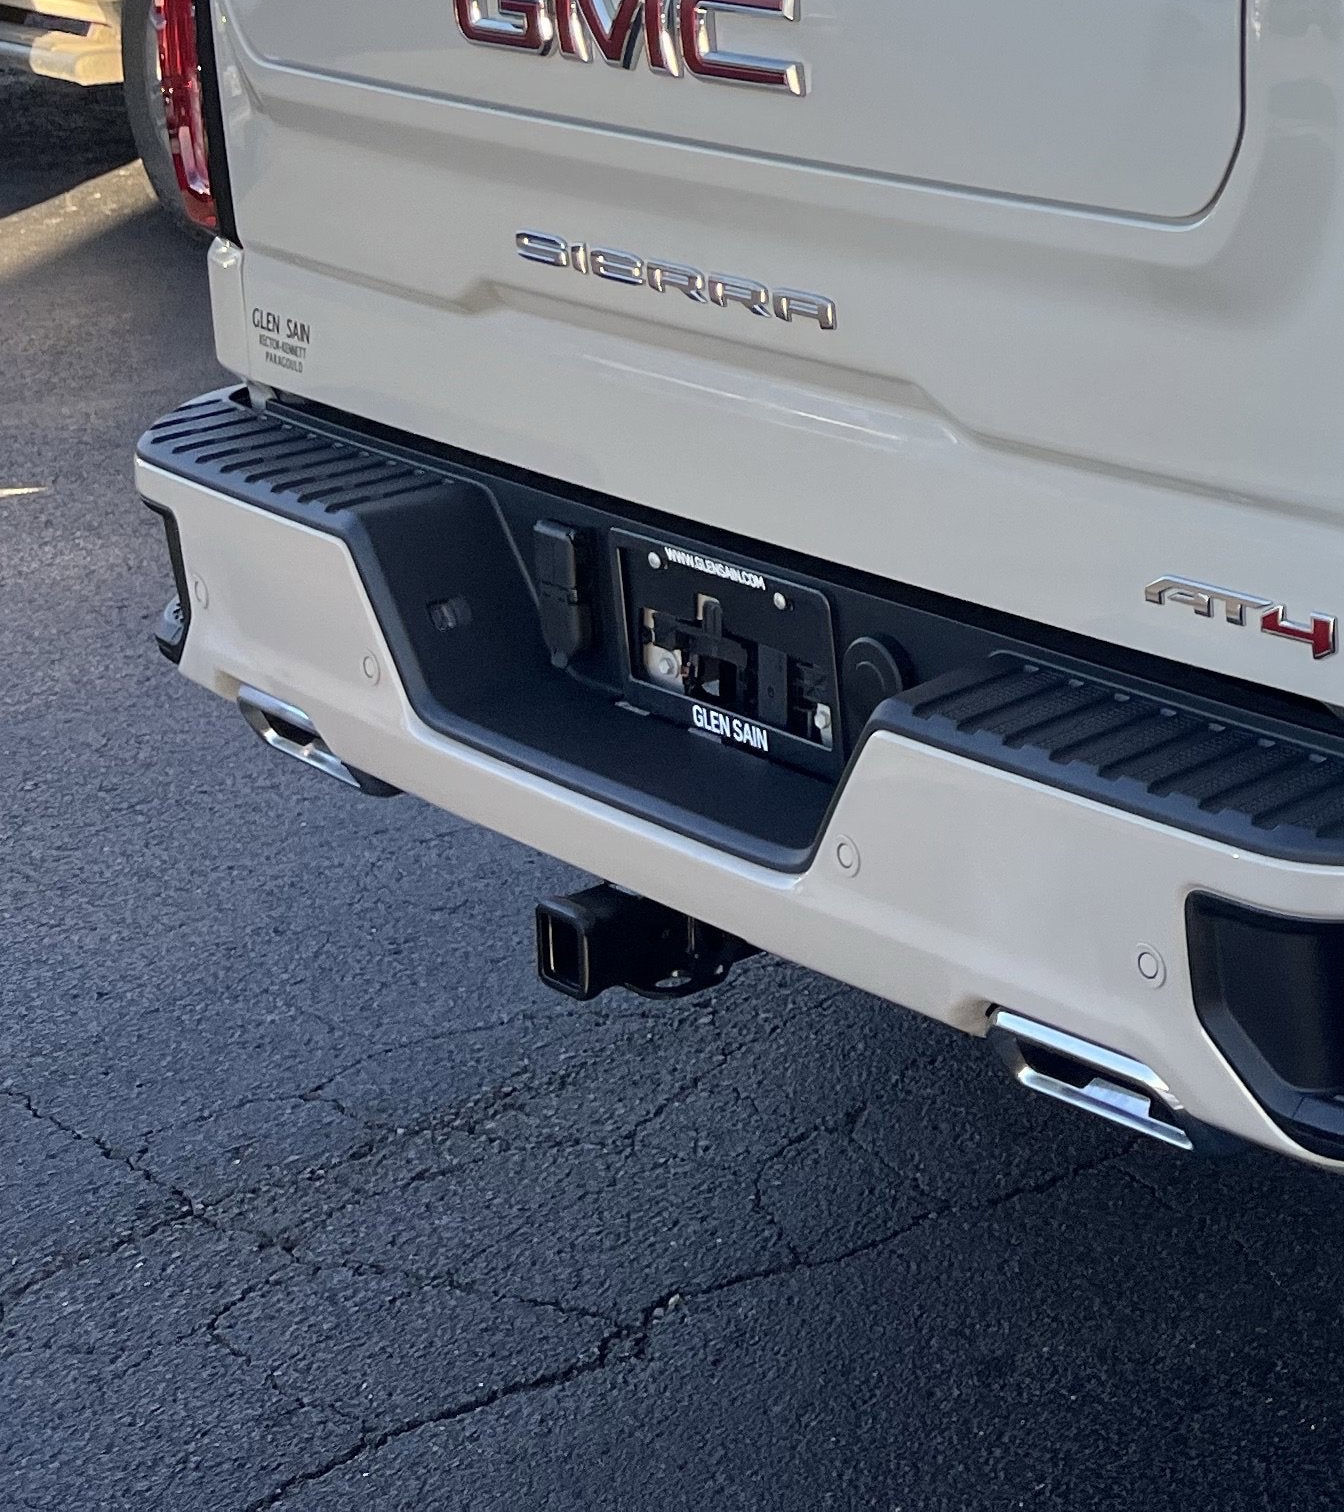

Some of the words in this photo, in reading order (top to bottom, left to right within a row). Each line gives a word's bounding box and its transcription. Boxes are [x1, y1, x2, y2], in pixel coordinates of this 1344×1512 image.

[516, 228, 837, 330] SIERRA
[252, 307, 280, 334] GLEN
[286, 318, 310, 344] SAIN
[664, 546, 766, 591] WWW.GLENSAIN.COM
[1144, 574, 1339, 661] AT4
[692, 704, 731, 738] GLEN
[732, 718, 769, 752] SAIN
